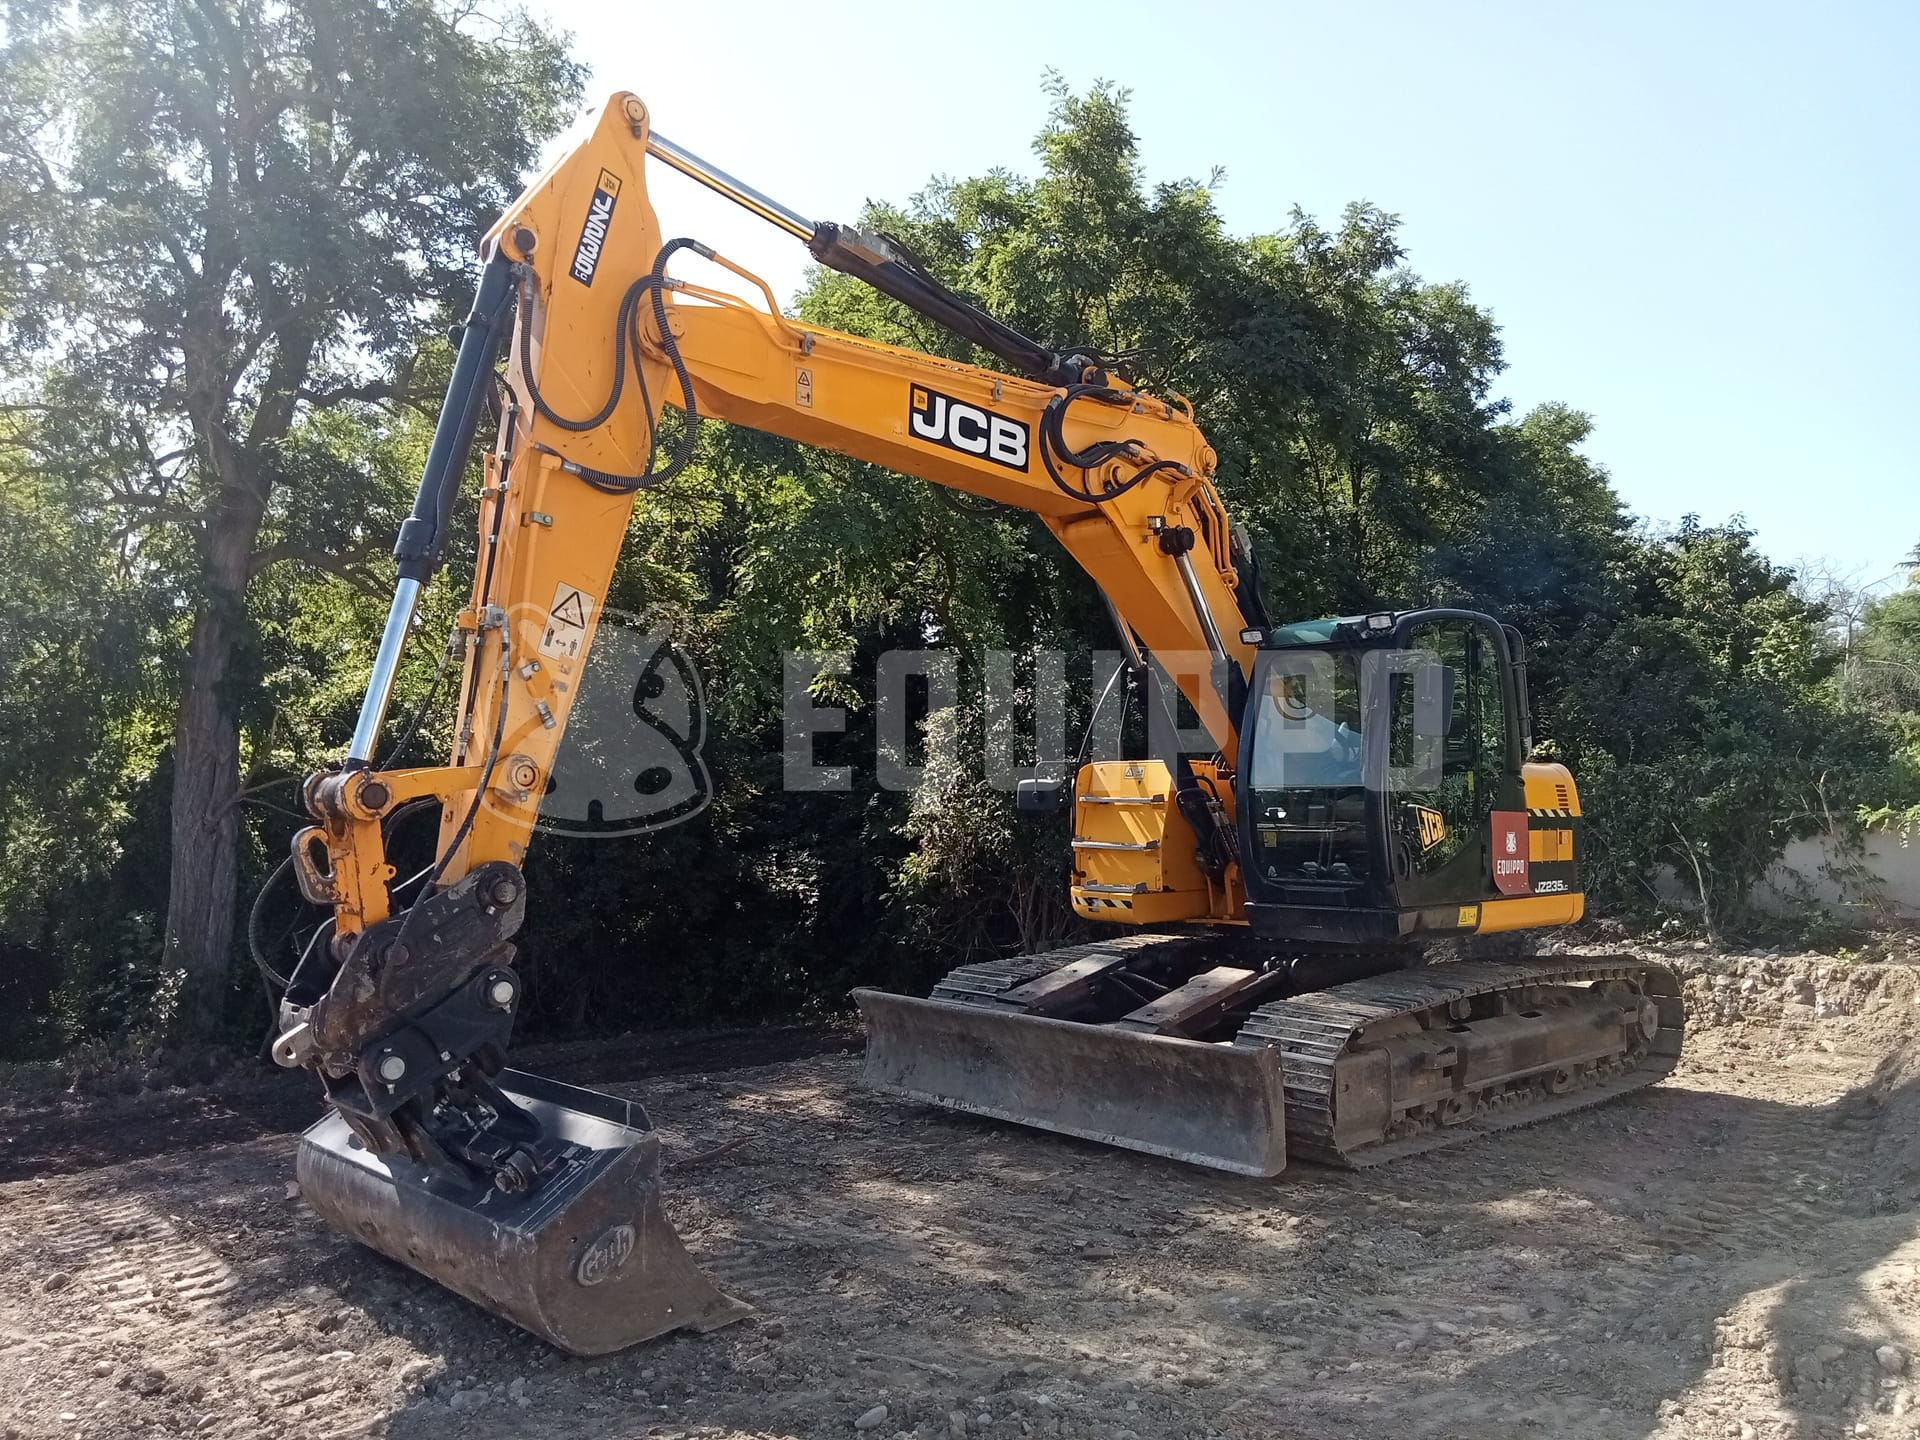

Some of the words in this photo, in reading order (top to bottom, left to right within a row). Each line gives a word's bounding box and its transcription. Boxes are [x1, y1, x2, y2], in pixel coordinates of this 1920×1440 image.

[912, 396, 1027, 467] JCB
[1421, 810, 1443, 846] JCB
[1497, 859, 1525, 876] EQUIPPO
